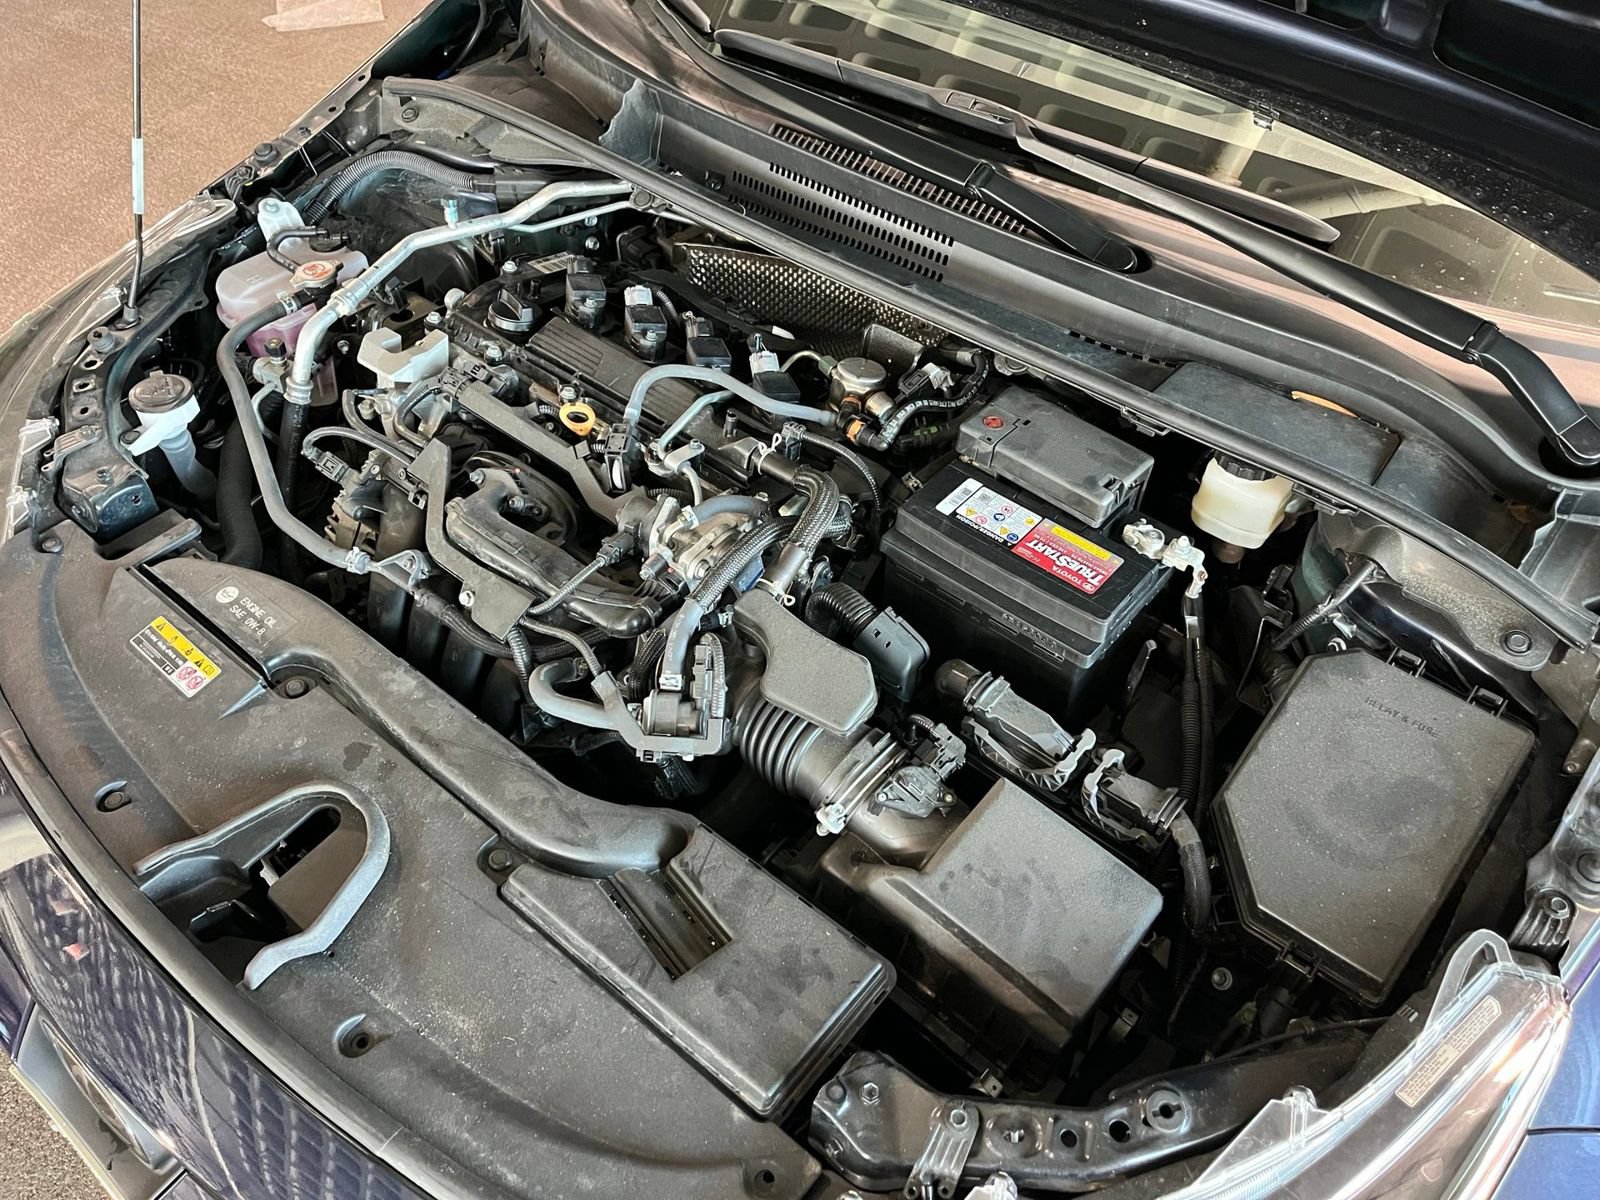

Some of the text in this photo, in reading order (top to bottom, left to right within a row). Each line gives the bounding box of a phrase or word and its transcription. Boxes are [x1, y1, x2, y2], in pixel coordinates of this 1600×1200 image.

[955, 513, 1004, 543] DANGER/POISON
[1025, 538, 1104, 587] TRUESTART
[1050, 563, 1083, 586] TOYOTA
[228, 604, 247, 620] SAE
[239, 595, 278, 629] ENGINE OIL
